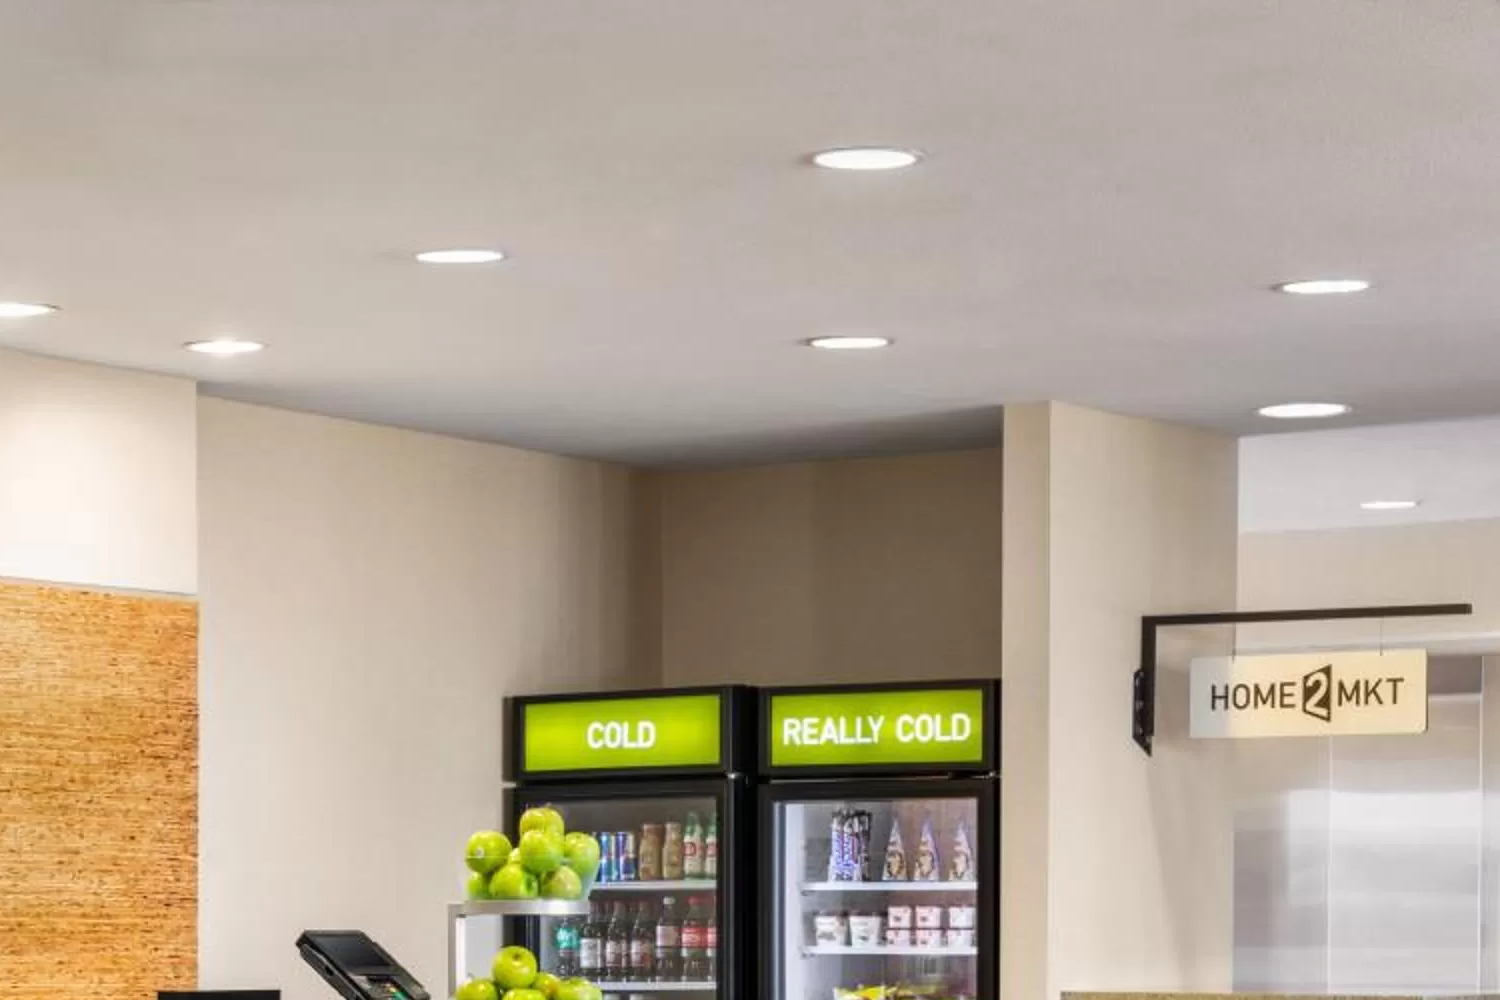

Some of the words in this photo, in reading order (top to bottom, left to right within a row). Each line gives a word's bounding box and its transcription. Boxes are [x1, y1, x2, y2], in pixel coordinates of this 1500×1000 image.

[587, 720, 656, 749] COLD
[783, 716, 885, 746] REALLY
[895, 713, 971, 744] COLD
